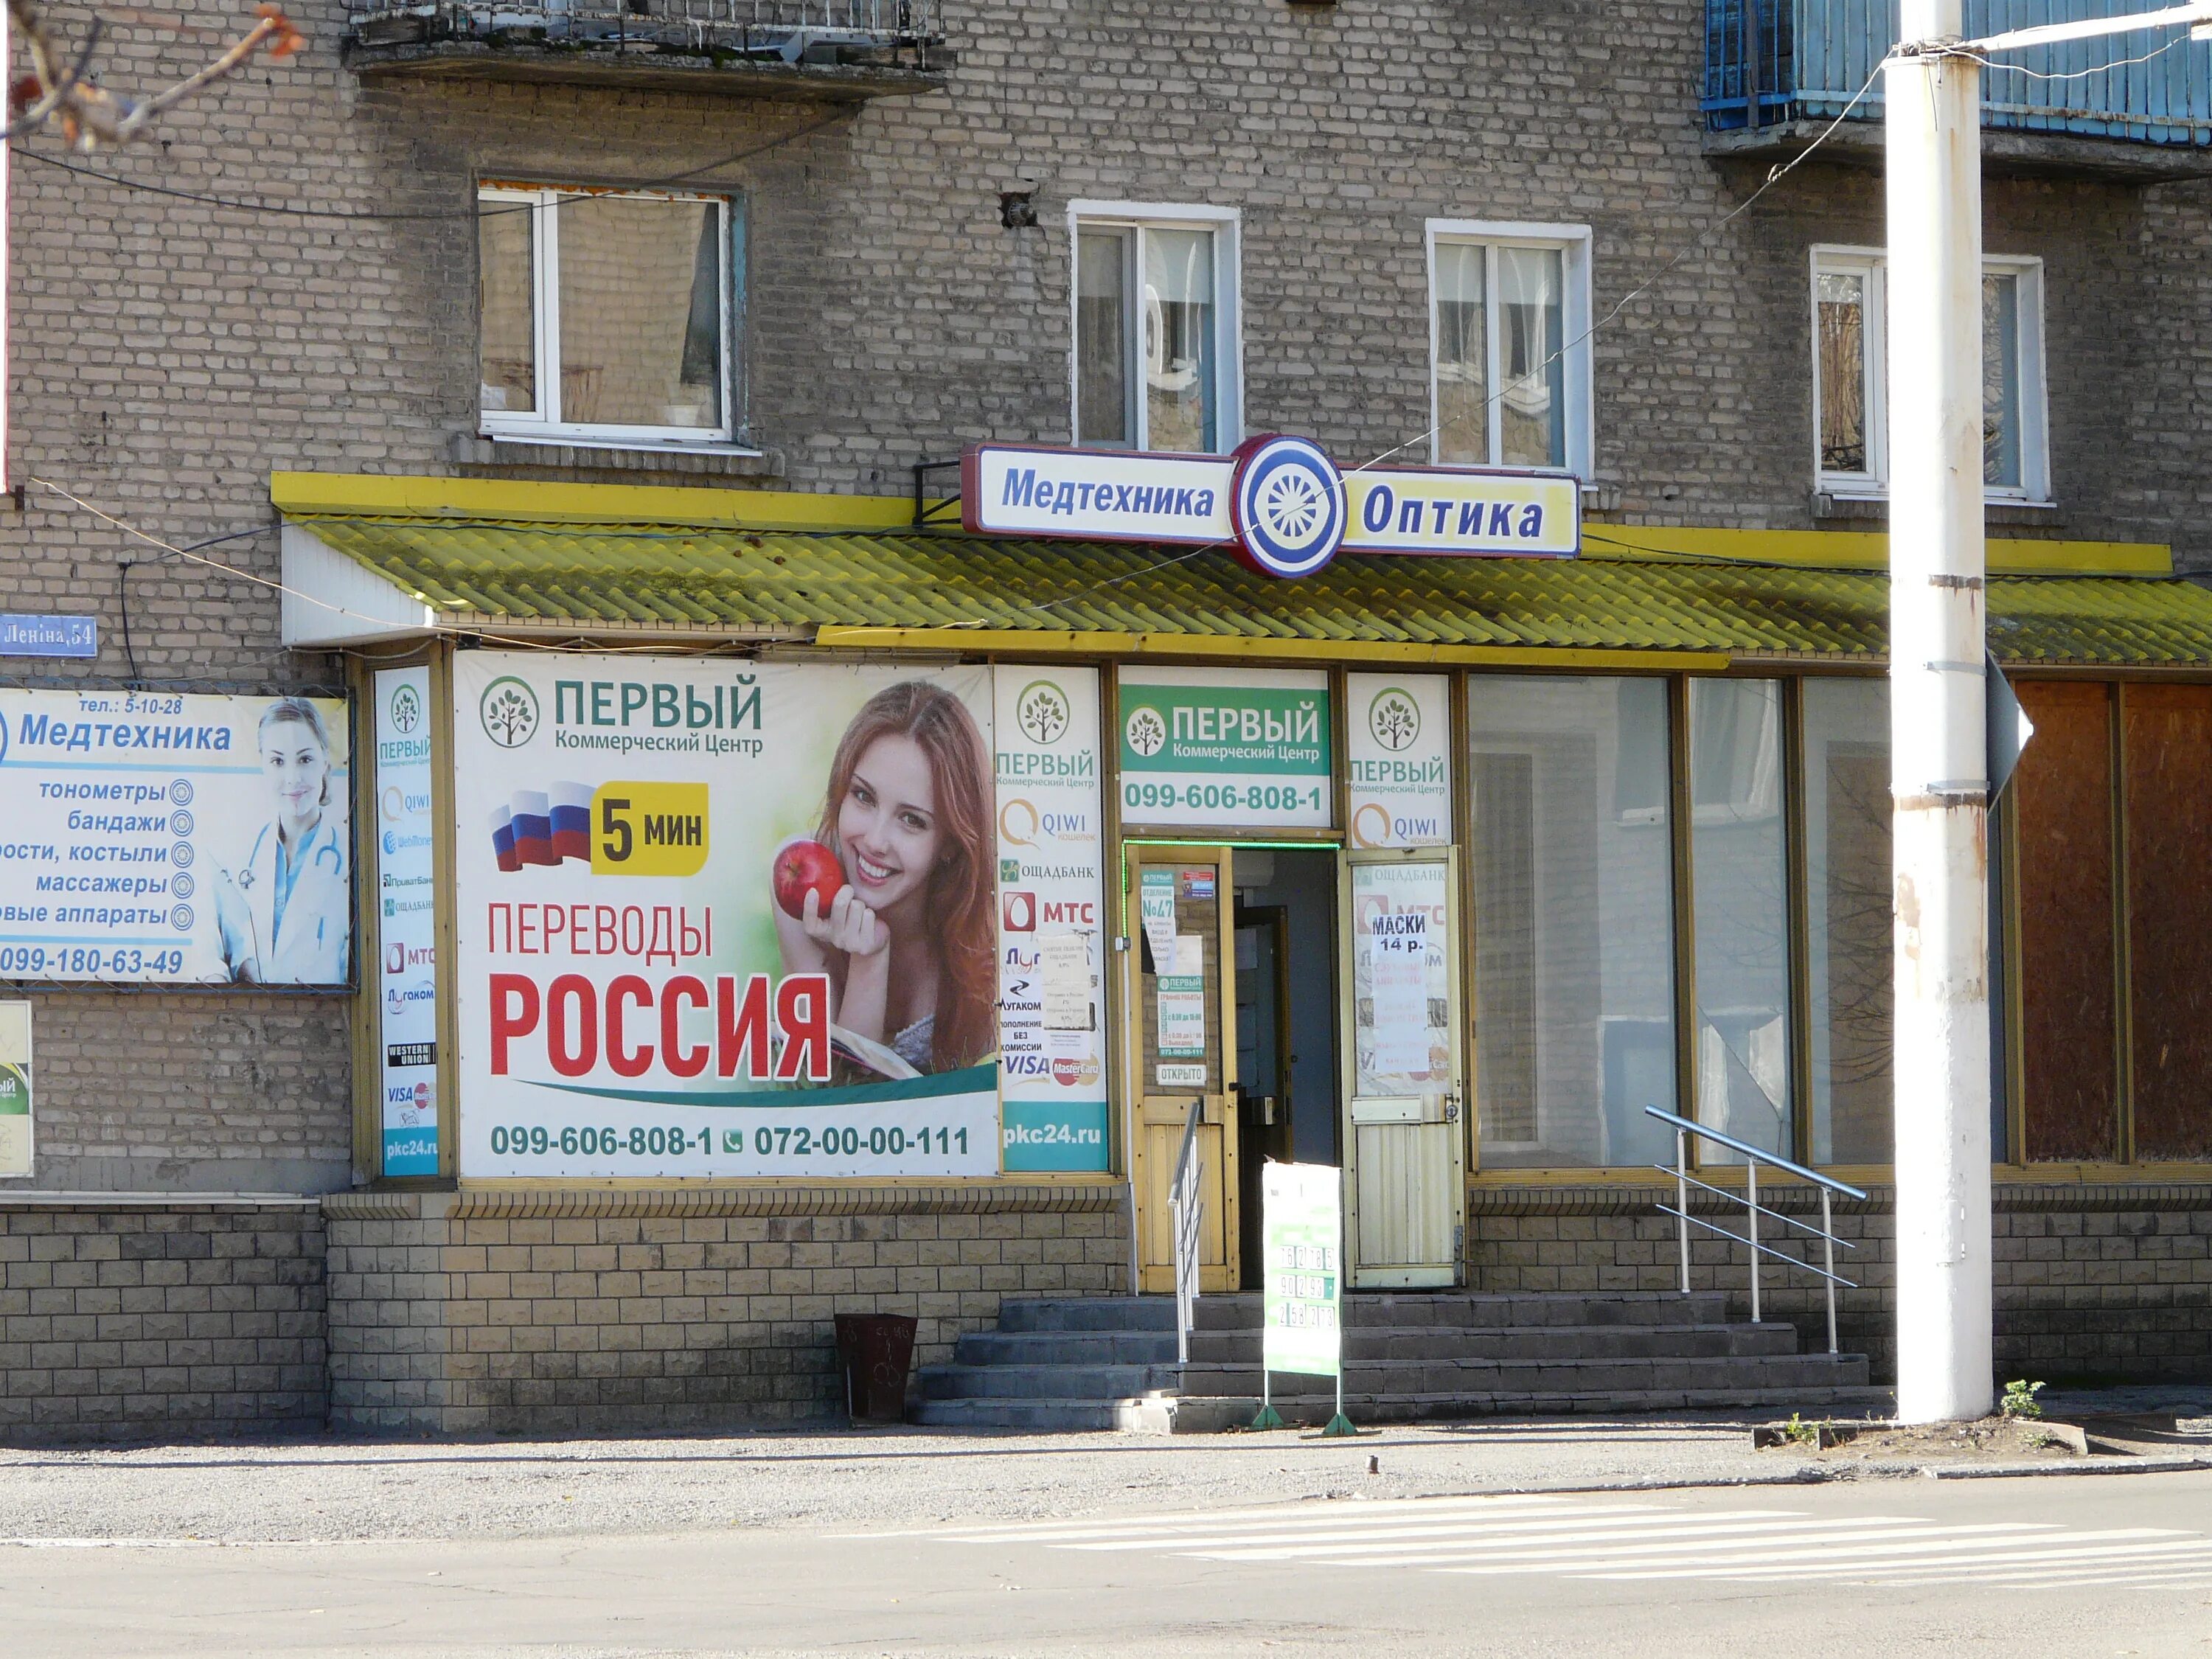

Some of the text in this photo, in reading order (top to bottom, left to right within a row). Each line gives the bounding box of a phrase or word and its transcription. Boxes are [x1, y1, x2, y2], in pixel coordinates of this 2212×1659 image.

[1001, 467, 1544, 538] Медтехника Оптика
[79, 698, 182, 714] тел.: 5-10-28
[554, 672, 762, 730] ПЕРВЫЙ
[18, 713, 232, 752] Медтехника
[1172, 700, 1318, 743] ПЕРВЫЙ
[554, 730, 763, 758] Коммерческий Центр
[1173, 743, 1320, 764] Коммерческий Центр
[995, 749, 1093, 776] ПЕРВЫЙ
[1349, 756, 1444, 782] ПЕРВЫЙ
[39, 782, 166, 804] тонометры
[996, 776, 1095, 790] Коммерческий Центр
[1418, 785, 1445, 796] Центр
[405, 794, 430, 810] QIWI
[1124, 783, 1321, 811] 099-606-808-1
[67, 810, 166, 834] бандажи
[601, 797, 633, 862] 5
[1042, 813, 1085, 837] QIWI
[1394, 818, 1436, 841] QIWI
[397, 834, 434, 848] WebMone
[1057, 832, 1096, 842] кошелек
[0, 844, 167, 863] ости, костыли
[392, 876, 434, 888] ПриватБан
[1021, 866, 1095, 880] ОЩАДБАНК
[1374, 869, 1445, 883] ОЩАДБАНК
[35, 875, 167, 897] массажеры
[0, 906, 167, 928] вые аппараты
[1043, 902, 1094, 924] МТС
[488, 902, 712, 967] ПЕРЕВОДЫ
[1372, 914, 1426, 936] МАСКИ
[1380, 937, 1423, 953] 14 р.
[0, 947, 183, 974] 099-180-63-49
[1170, 977, 1202, 987] ПЕРВЫЙ
[488, 973, 831, 1079] РОССИЯ
[1013, 1032, 1028, 1040] БЕЗ
[389, 1044, 429, 1056] WESTERN
[401, 1054, 428, 1065] UNION
[1005, 1055, 1051, 1075] VISA
[1054, 1062, 1099, 1074] MasterCard
[1161, 1068, 1202, 1080] ОТКРЫТО
[388, 1087, 413, 1102] VISA
[490, 1125, 969, 1157] 099-606-808-1 072-00-00-111
[1003, 1124, 1101, 1149] pkc24.ru
